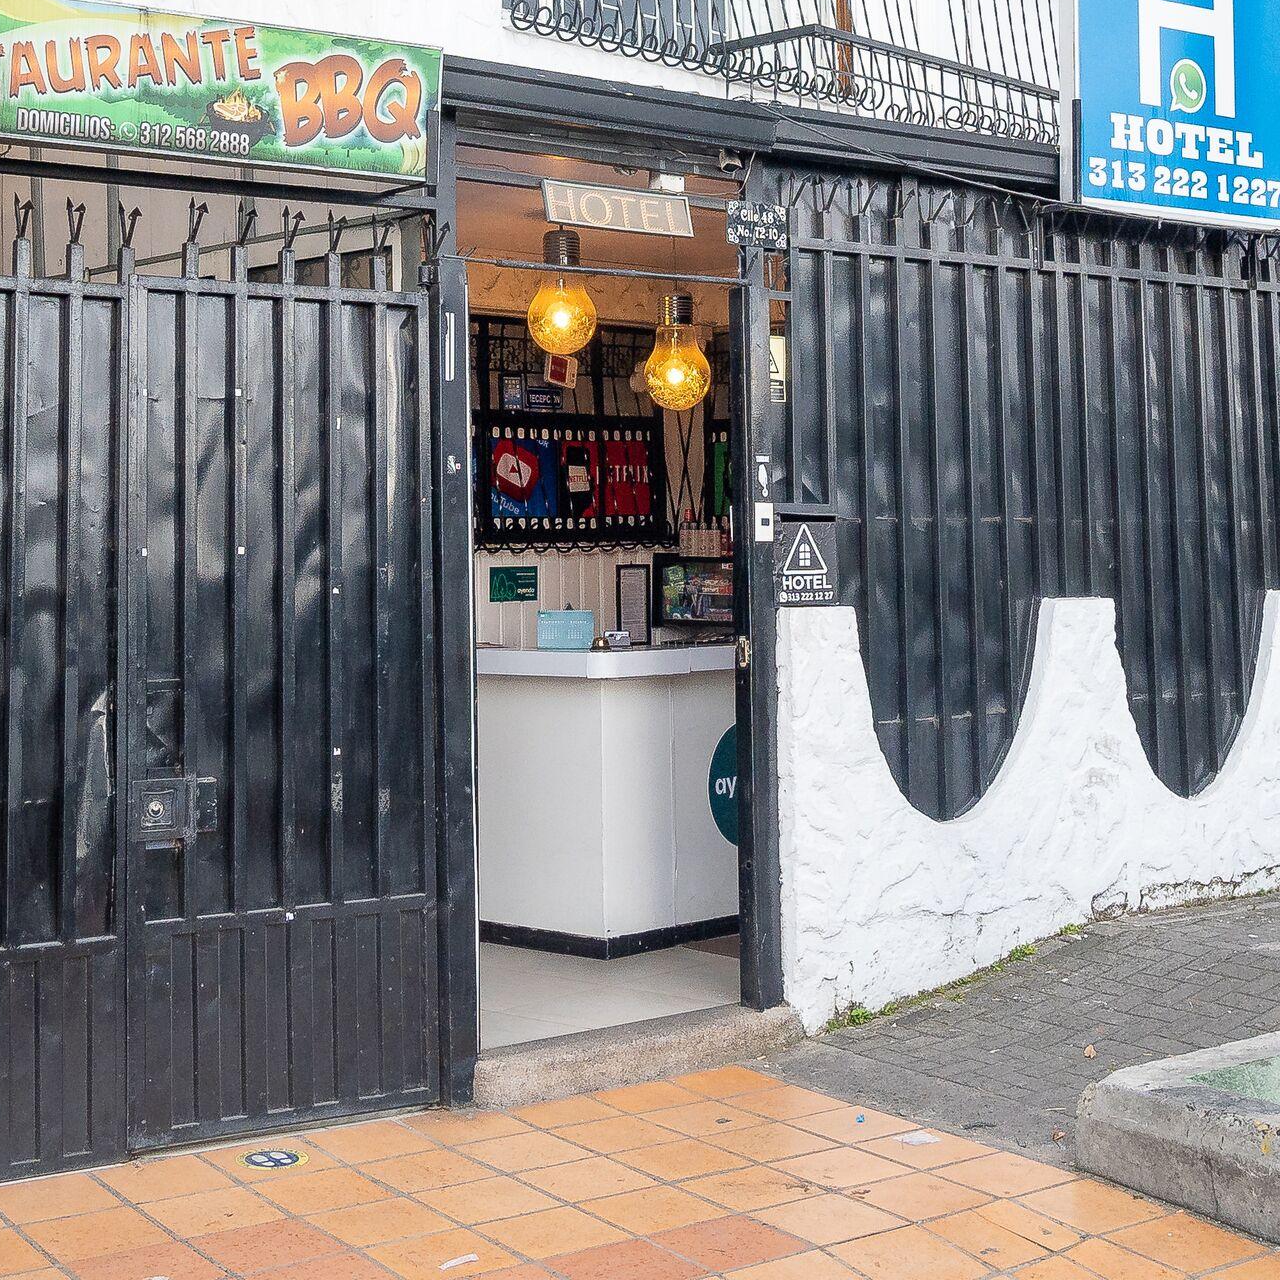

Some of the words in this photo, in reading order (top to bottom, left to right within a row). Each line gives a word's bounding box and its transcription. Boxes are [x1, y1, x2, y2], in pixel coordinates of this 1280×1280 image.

[274, 55, 422, 147] BBQ
[17, 107, 116, 141] DOMICILIOS:
[140, 124, 172, 150] 312
[174, 127, 207, 152] 568
[208, 130, 251, 156] 2888
[1110, 112, 1264, 170] HOTEL
[1089, 156, 1146, 192] 313
[1154, 165, 1208, 199] 222
[547, 184, 688, 234] HOTEL
[761, 211, 774, 224] 48
[782, 574, 833, 590] HOTEL
[787, 592, 800, 602] 313
[800, 592, 814, 601] 222
